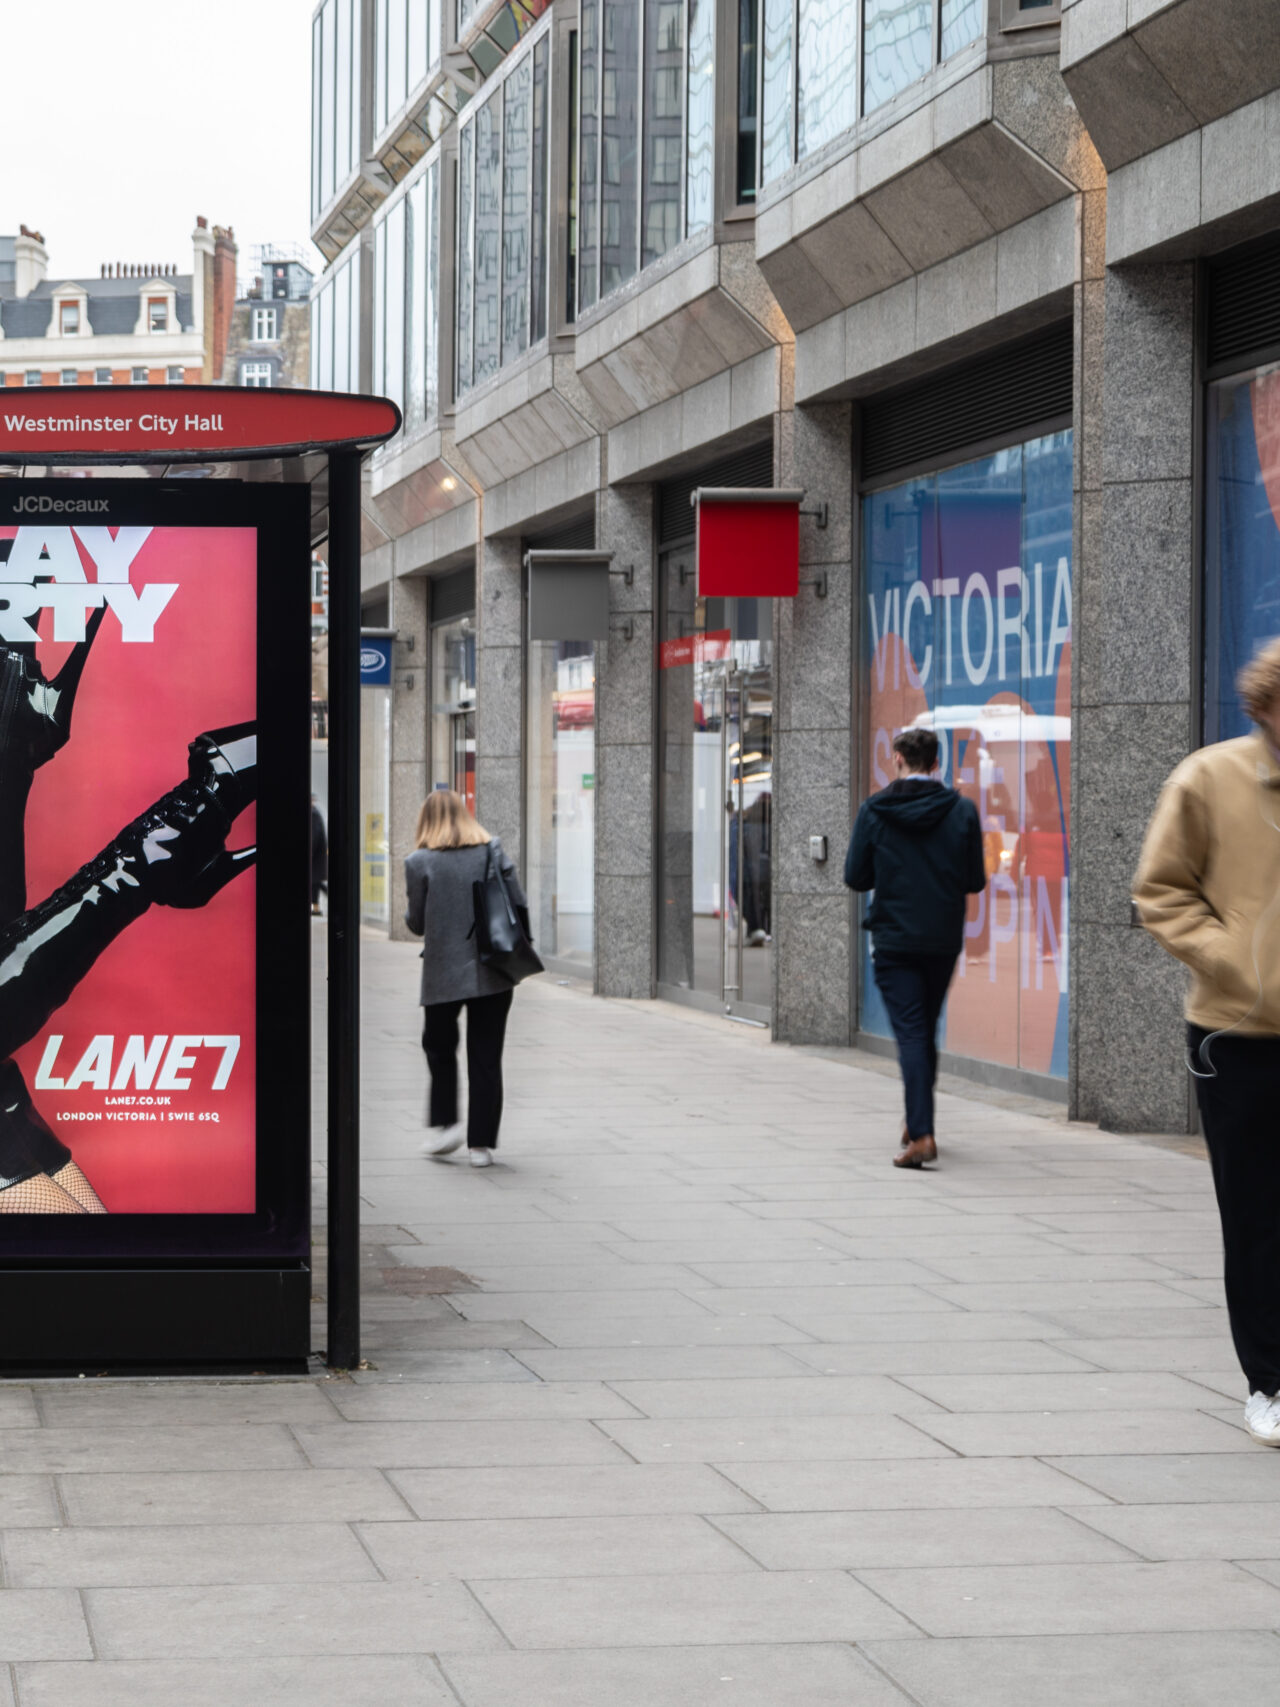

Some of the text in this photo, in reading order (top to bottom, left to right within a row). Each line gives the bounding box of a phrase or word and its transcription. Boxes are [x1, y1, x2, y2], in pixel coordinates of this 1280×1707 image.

[4, 414, 224, 435] Westminster City Hall
[12, 495, 110, 513] JCDecaux
[868, 556, 1072, 693] VICTORIA
[34, 1034, 241, 1090] LANE7
[105, 1096, 171, 1106] LANE7.CO.UK
[56, 1112, 220, 1123] LONDON VICTORIA SW1E 6SQ
